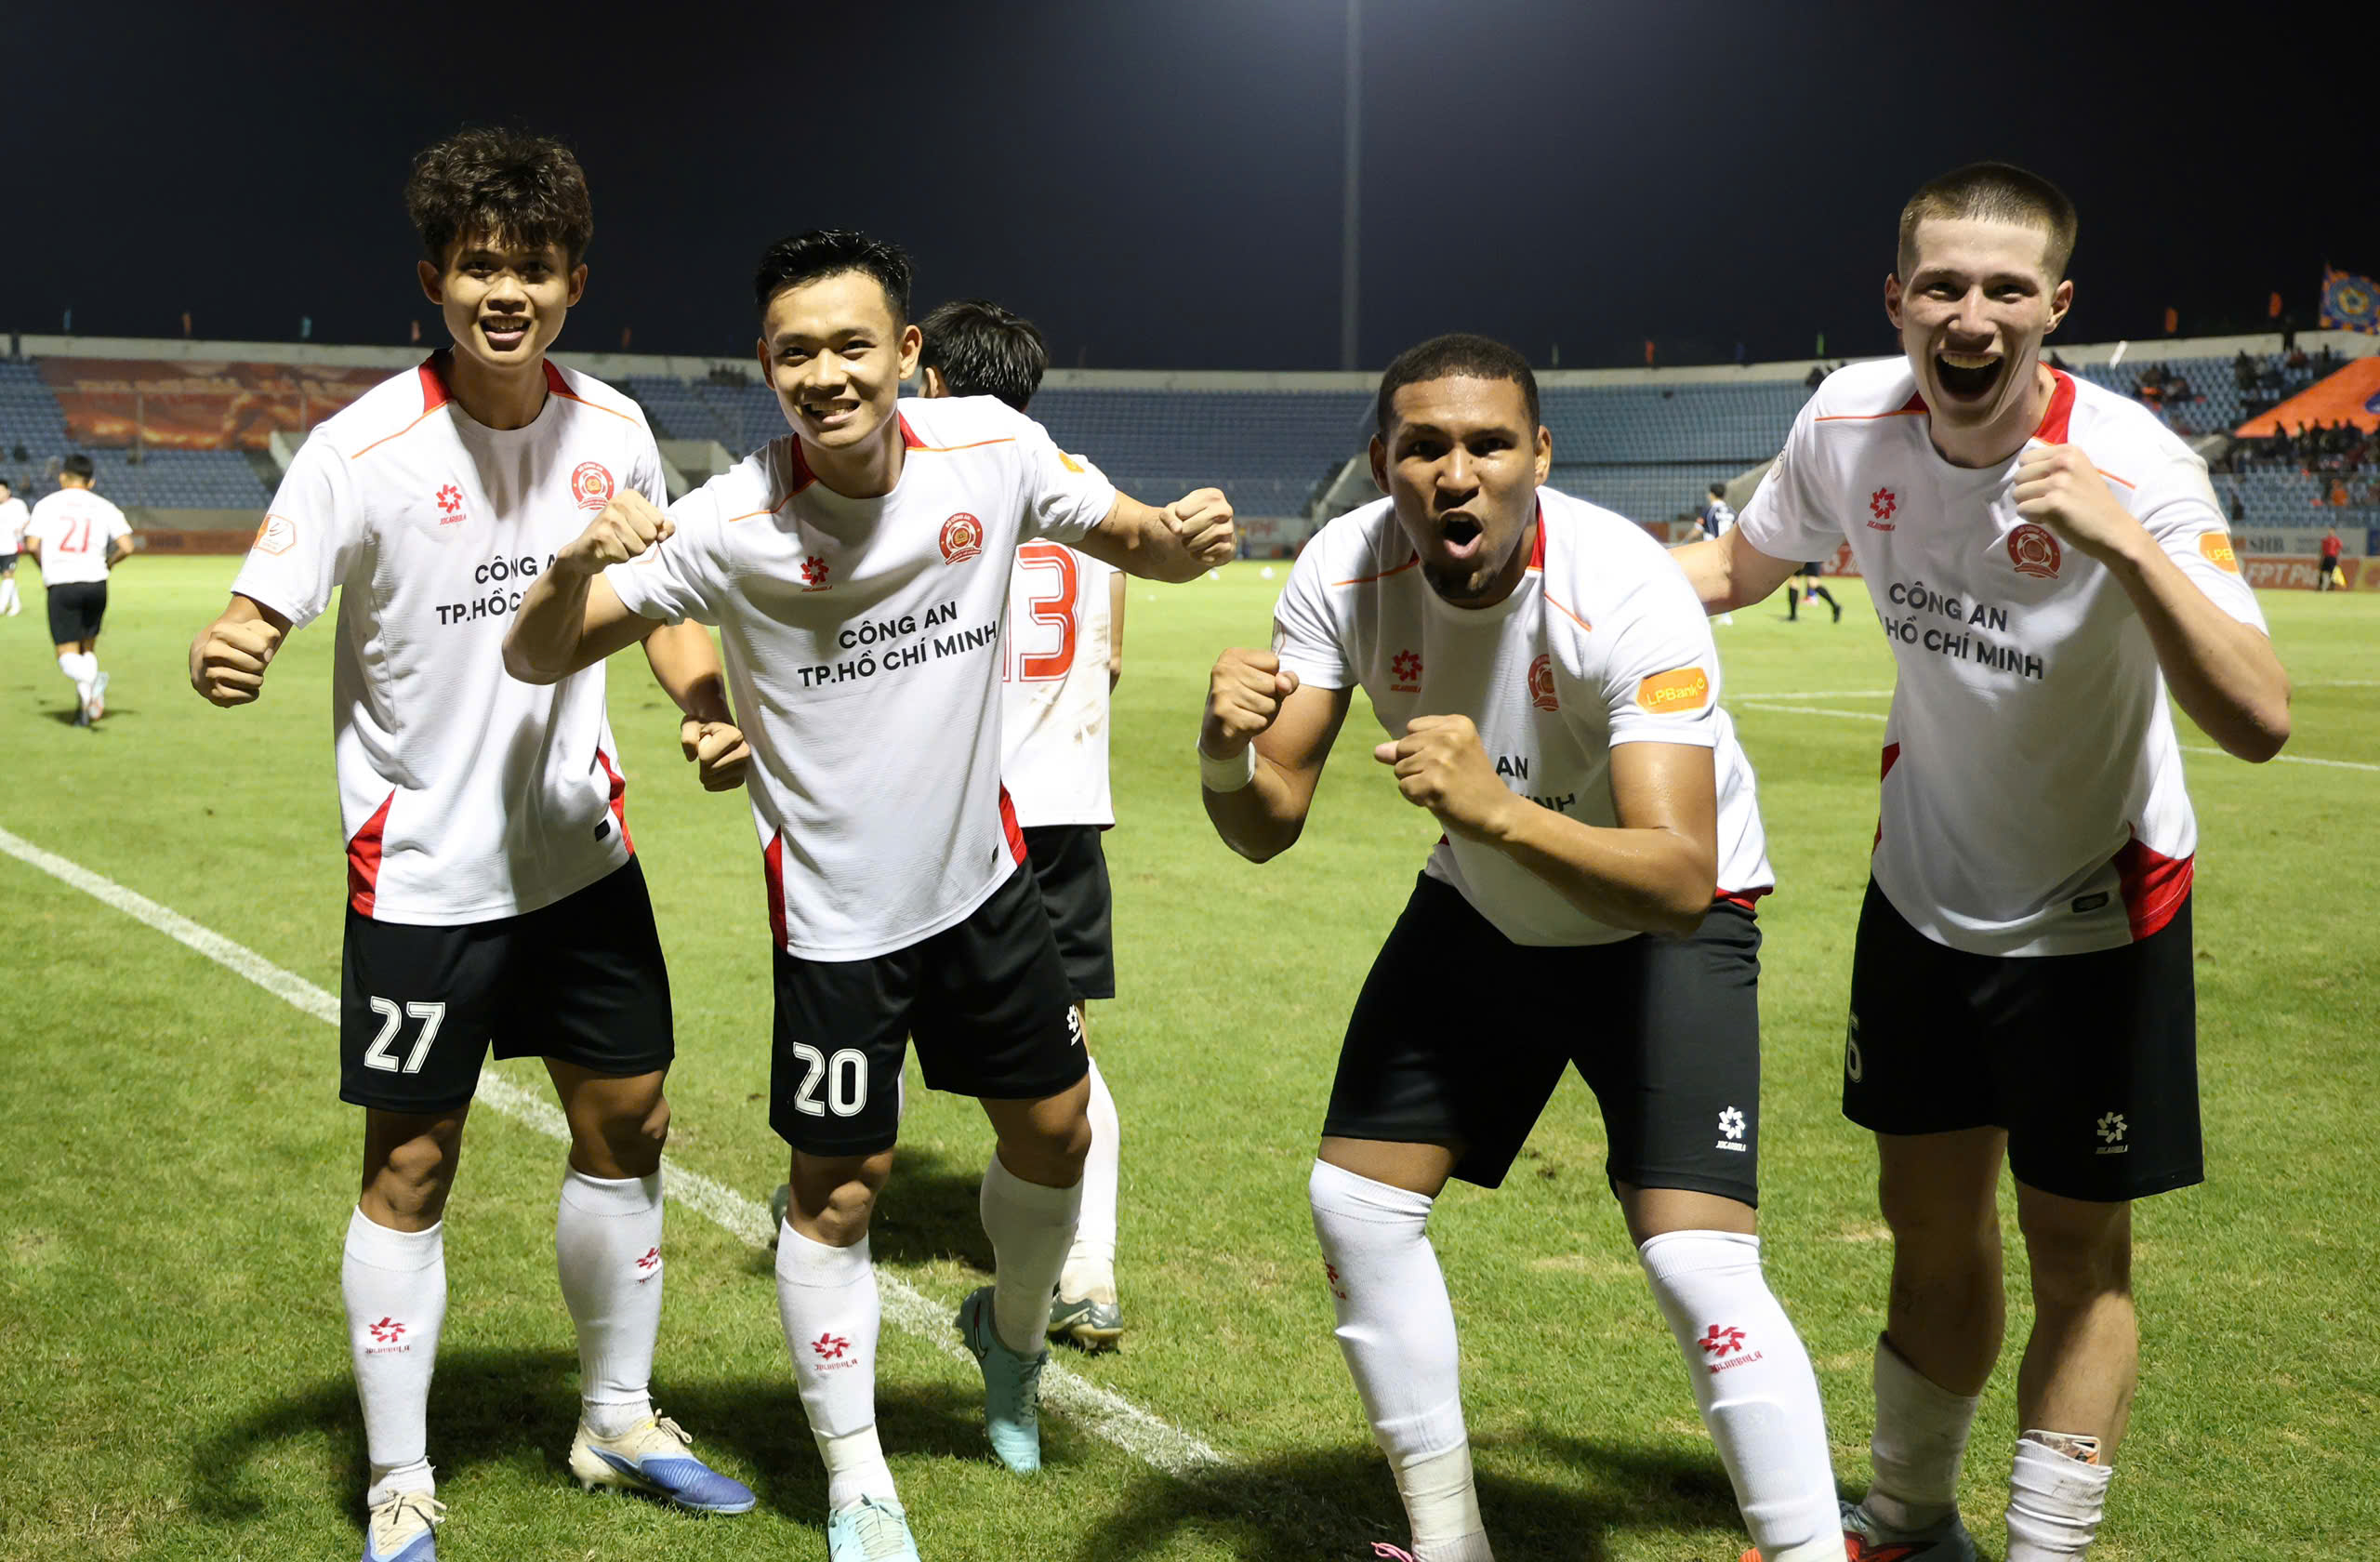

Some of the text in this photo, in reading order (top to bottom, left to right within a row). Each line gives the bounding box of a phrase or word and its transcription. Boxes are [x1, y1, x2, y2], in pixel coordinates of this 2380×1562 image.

[59, 516, 91, 553] 21
[475, 555, 537, 584] CÔNG
[436, 588, 507, 625] TP.HỒ
[839, 602, 958, 649] CÔNG AN
[1003, 540, 1079, 682] 3
[1889, 581, 2007, 631] CÔNG AN
[798, 621, 998, 687] TP.HỒ CHÍ MINH
[1876, 608, 2043, 680] HỒ CHÍ MINH
[1646, 684, 1699, 707] LPBank
[1496, 756, 1528, 780] AN
[364, 996, 445, 1074] 27
[793, 1041, 868, 1117] 20
